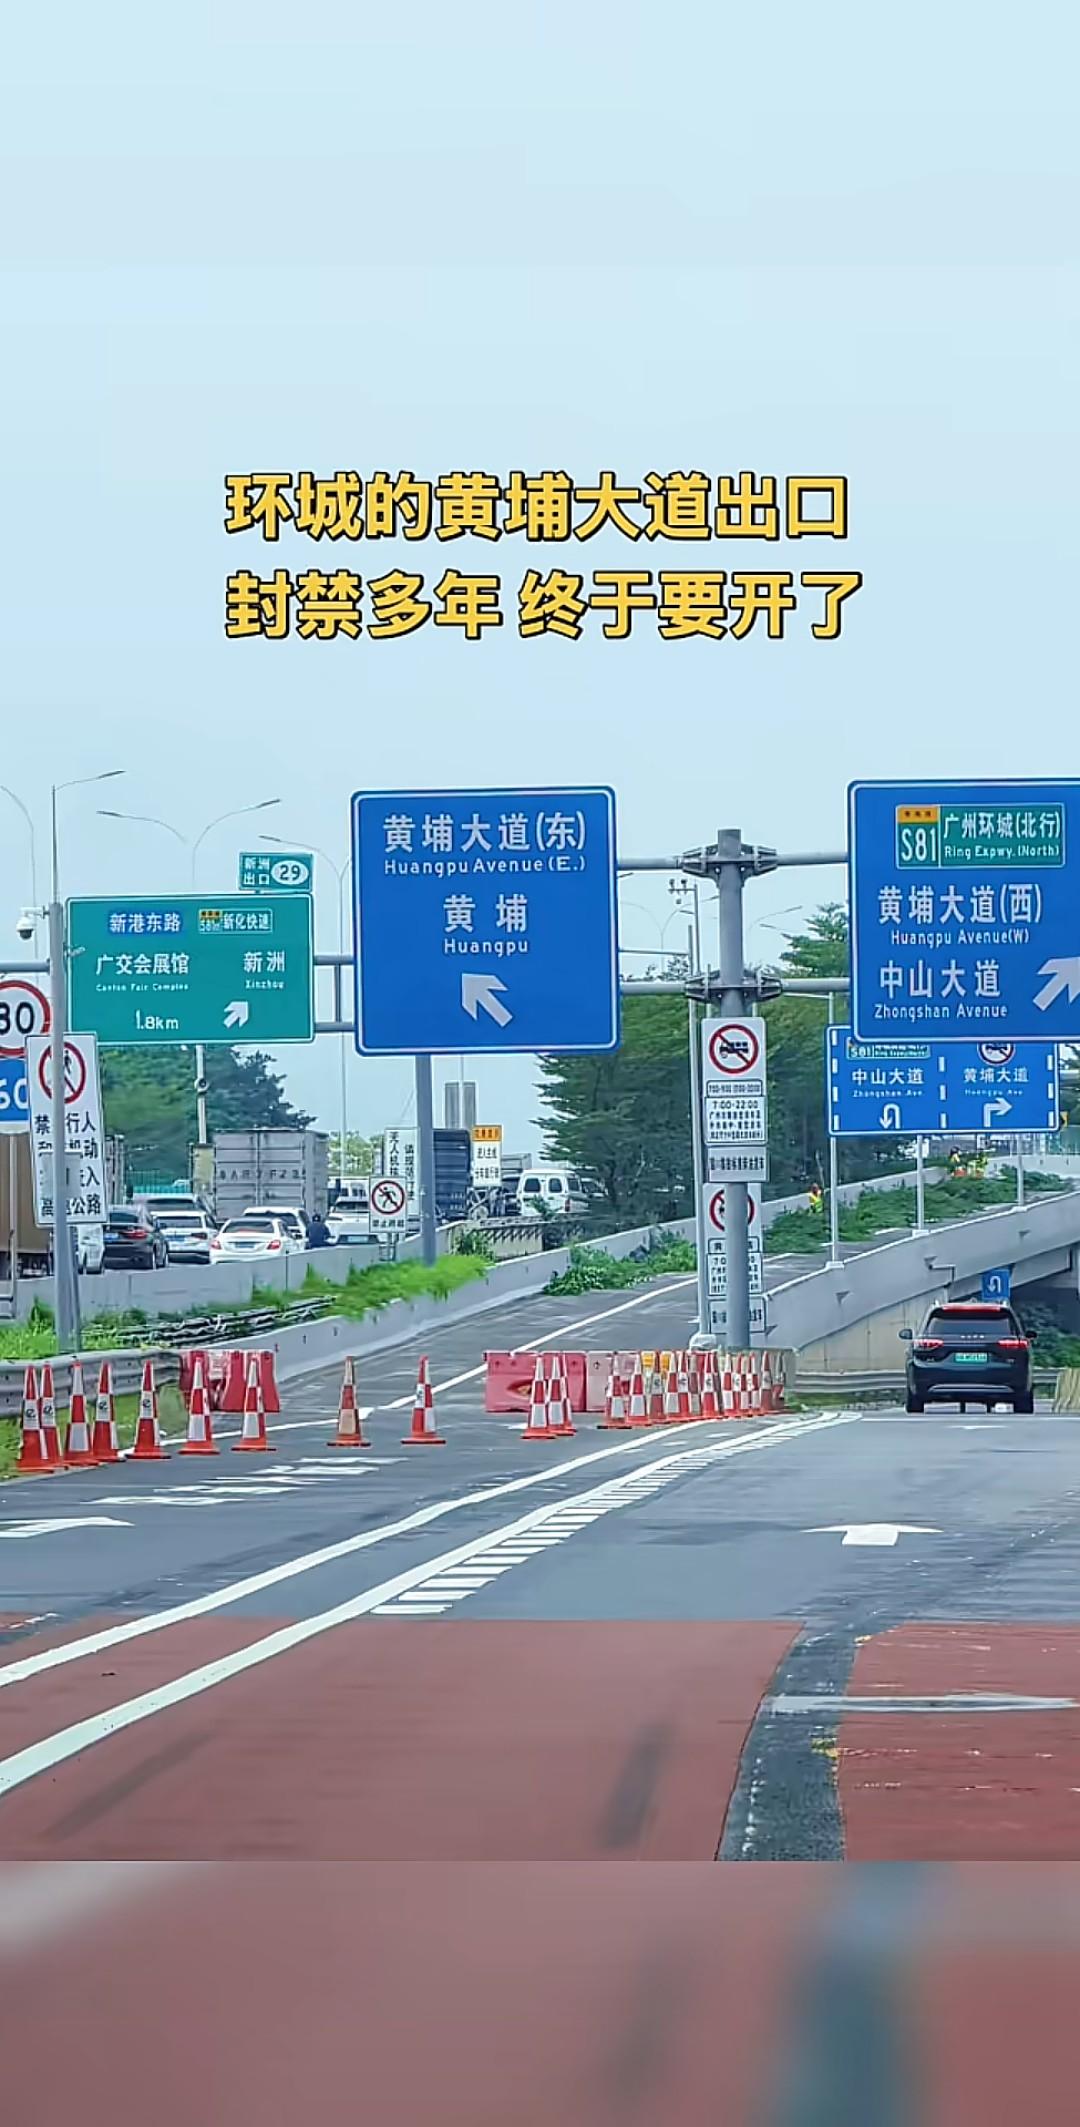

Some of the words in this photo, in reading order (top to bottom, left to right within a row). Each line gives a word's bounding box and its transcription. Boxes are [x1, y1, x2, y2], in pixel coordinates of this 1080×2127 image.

[382, 810, 587, 854] 黄埔大道(东)
[943, 811, 1061, 840] 广州环城(北行)
[901, 827, 937, 863] S81
[944, 845, 972, 861] Ring
[243, 872, 270, 885] 出口
[280, 864, 302, 882] 29
[384, 859, 468, 878] Huangpu
[473, 857, 543, 873] Avenue
[442, 893, 529, 933] 黄埔
[877, 883, 1042, 925] 黄埔大道(西)
[109, 911, 181, 933] 新港东路
[223, 913, 270, 931] 新化快速
[443, 938, 529, 957] Huangpu
[890, 929, 952, 949] Huangpu
[96, 952, 190, 976] 广交会展馆
[243, 951, 286, 973] 新洲
[879, 958, 1002, 1000] 中山大道
[135, 1009, 180, 1031] 1.8km
[873, 1003, 950, 1022] Zhongshan
[956, 1002, 1008, 1019] Avenue
[851, 1067, 924, 1086] 中山大道
[963, 1066, 1030, 1085] 黄埔大道
[34, 1111, 97, 1136] 禁行人
[41, 1194, 102, 1217] 高公路
